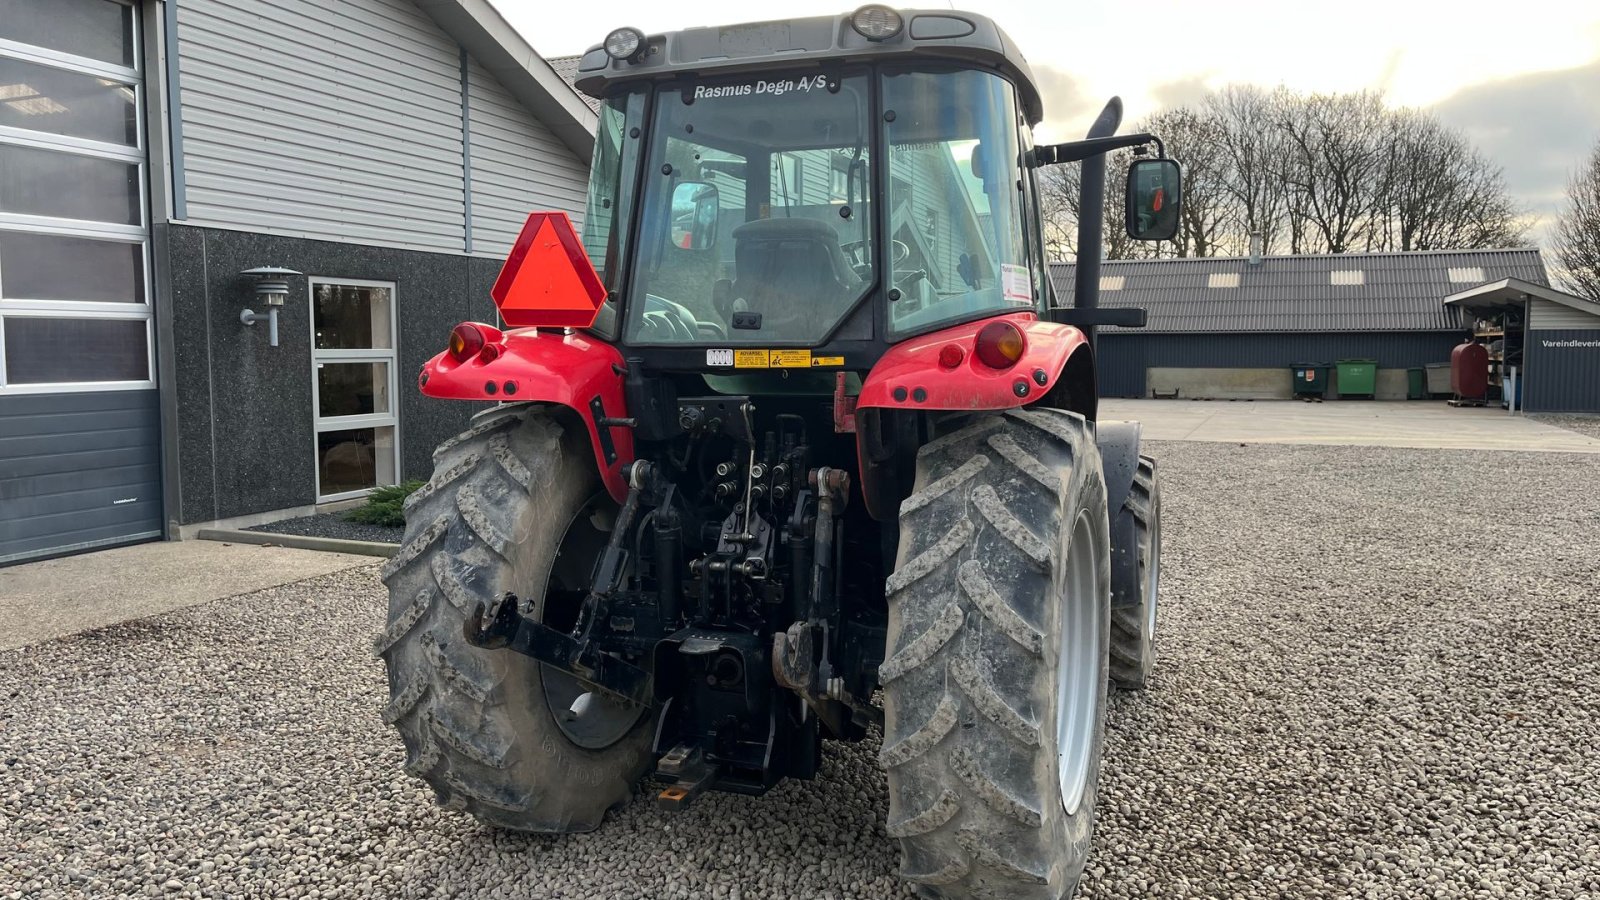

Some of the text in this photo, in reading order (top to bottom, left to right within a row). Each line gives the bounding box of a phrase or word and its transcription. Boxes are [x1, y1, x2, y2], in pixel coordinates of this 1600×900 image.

[694, 75, 826, 98] Rasmus Degn A/S
